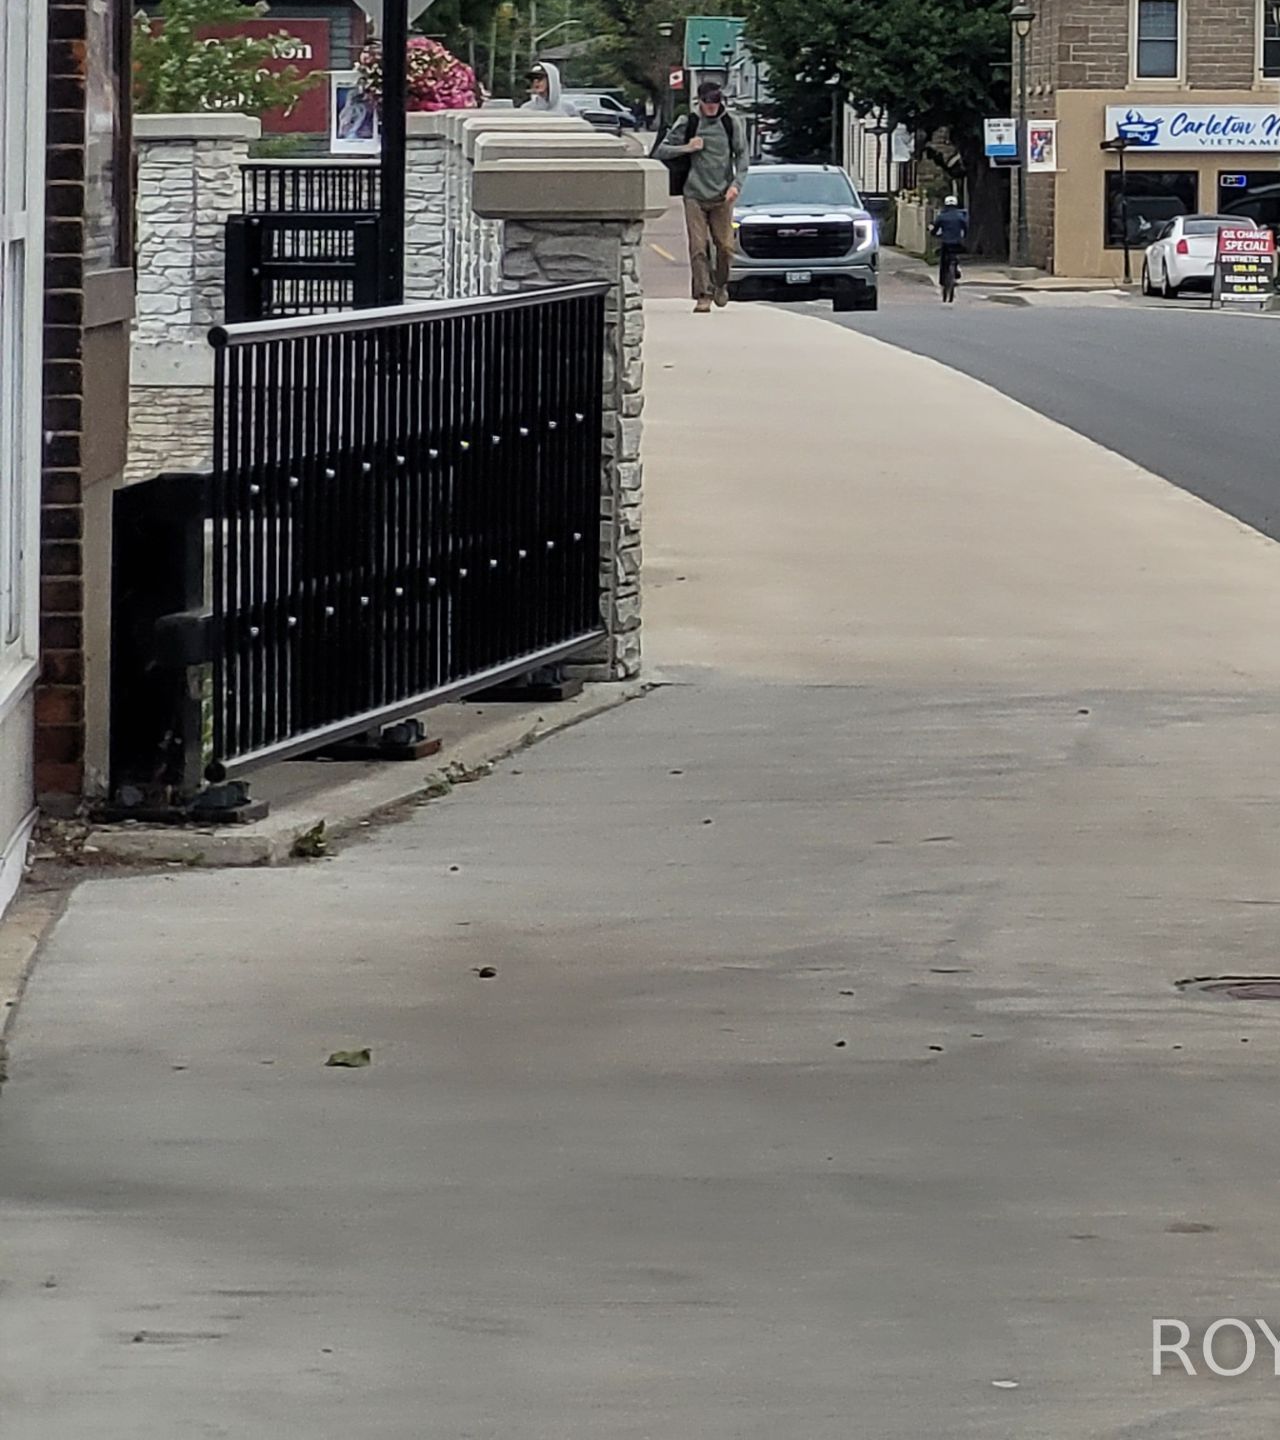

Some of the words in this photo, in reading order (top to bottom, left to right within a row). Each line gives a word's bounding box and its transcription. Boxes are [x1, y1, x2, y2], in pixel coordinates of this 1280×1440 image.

[1170, 112, 1255, 137] Carleton
[1199, 138, 1279, 146] VIETNAME
[777, 229, 818, 237] GMC
[1221, 230, 1235, 239] OIL
